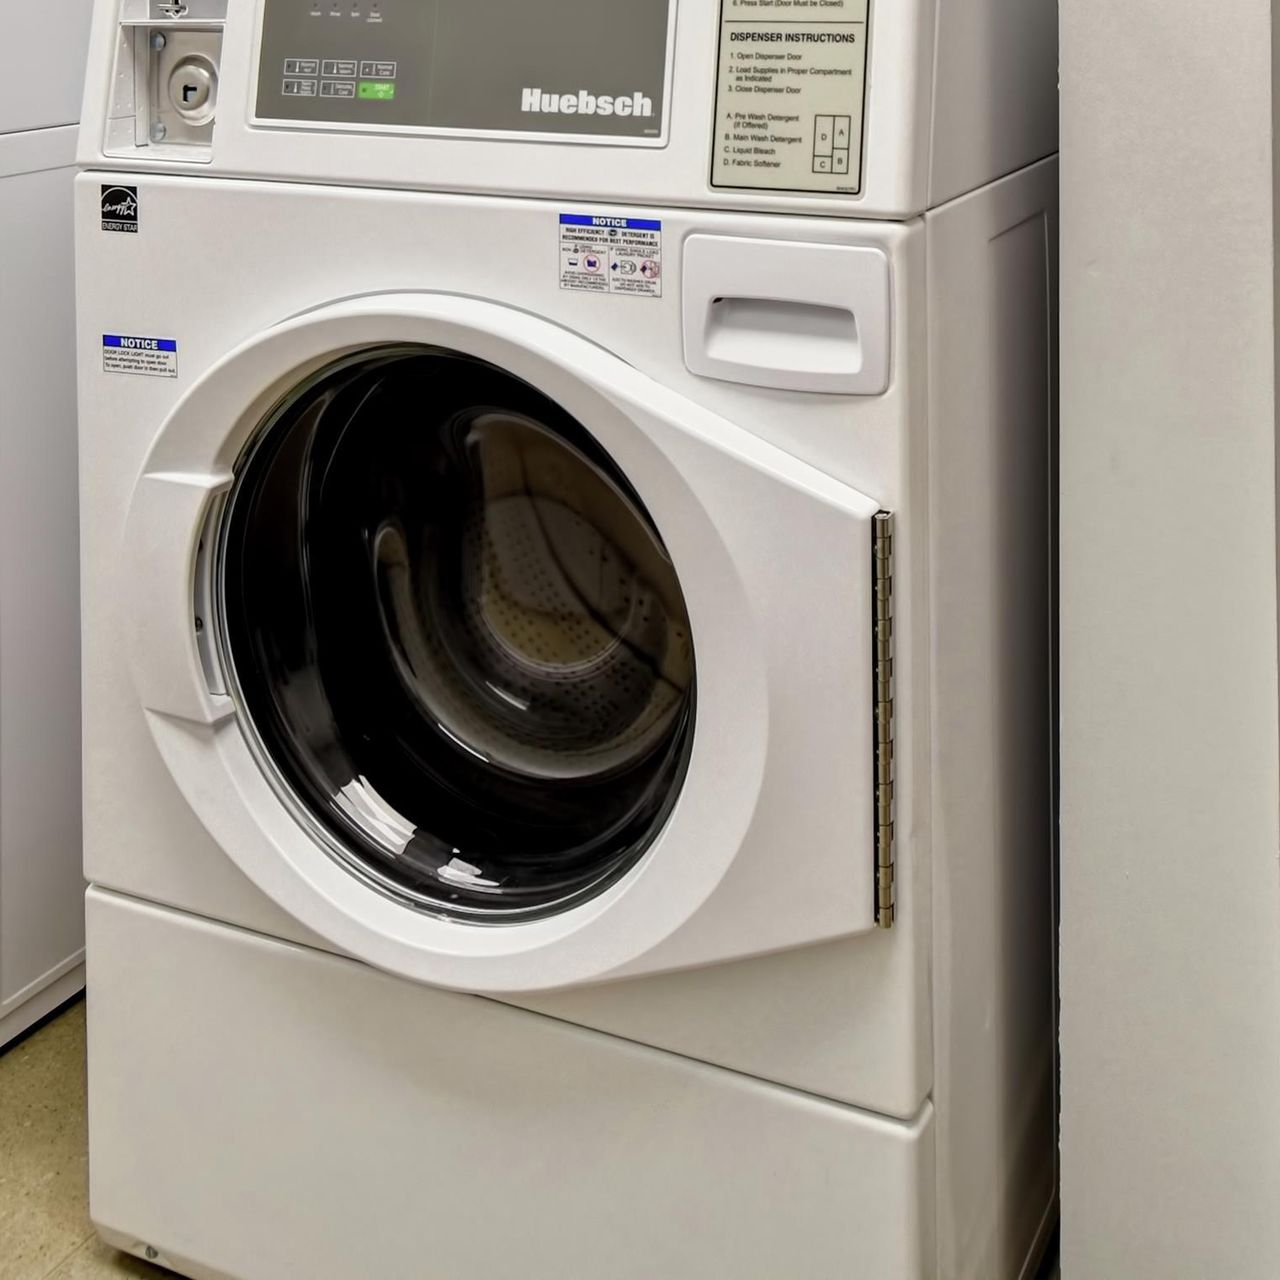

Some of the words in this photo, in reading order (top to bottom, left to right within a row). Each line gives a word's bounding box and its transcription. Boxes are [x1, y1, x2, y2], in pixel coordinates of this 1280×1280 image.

[730, 32, 782, 41] DISPENSER
[784, 33, 855, 43] INSTRUCTIONS
[521, 88, 652, 117] Huebsch
[592, 218, 627, 227] NOTICE
[120, 338, 158, 349] NOTICE
